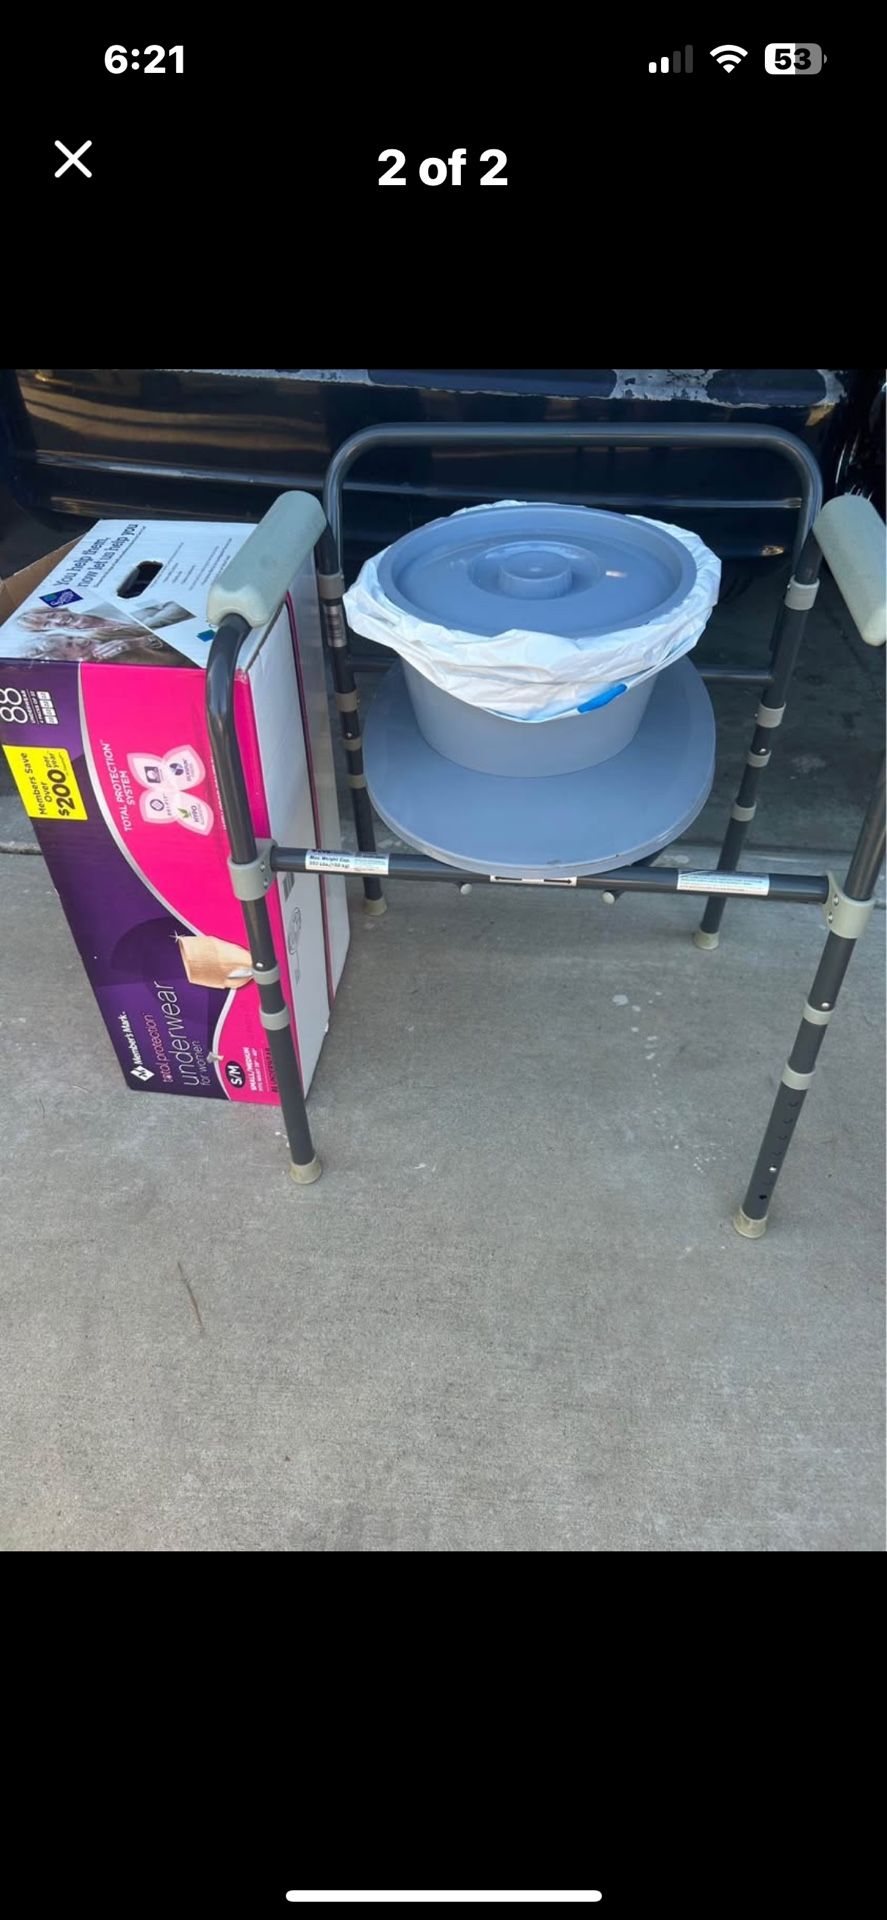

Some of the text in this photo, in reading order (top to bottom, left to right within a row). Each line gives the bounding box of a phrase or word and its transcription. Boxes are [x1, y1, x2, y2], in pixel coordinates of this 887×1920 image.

[53, 571, 78, 586] You
[67, 556, 93, 572] help
[82, 537, 111, 555] them,
[78, 523, 139, 587] now let us help you
[0, 687, 28, 724] 88
[43, 756, 53, 767] per
[20, 753, 47, 814] Members Save
[40, 782, 53, 802] Over
[47, 769, 76, 816] $200
[119, 770, 135, 806] SYSTEM
[118, 804, 133, 832] TOTAL
[124, 1034, 143, 1064] Member's
[143, 1014, 174, 1083] total protection
[152, 980, 200, 1086] underwear
[192, 1040, 211, 1086] for women
[227, 1065, 243, 1086] S/M
